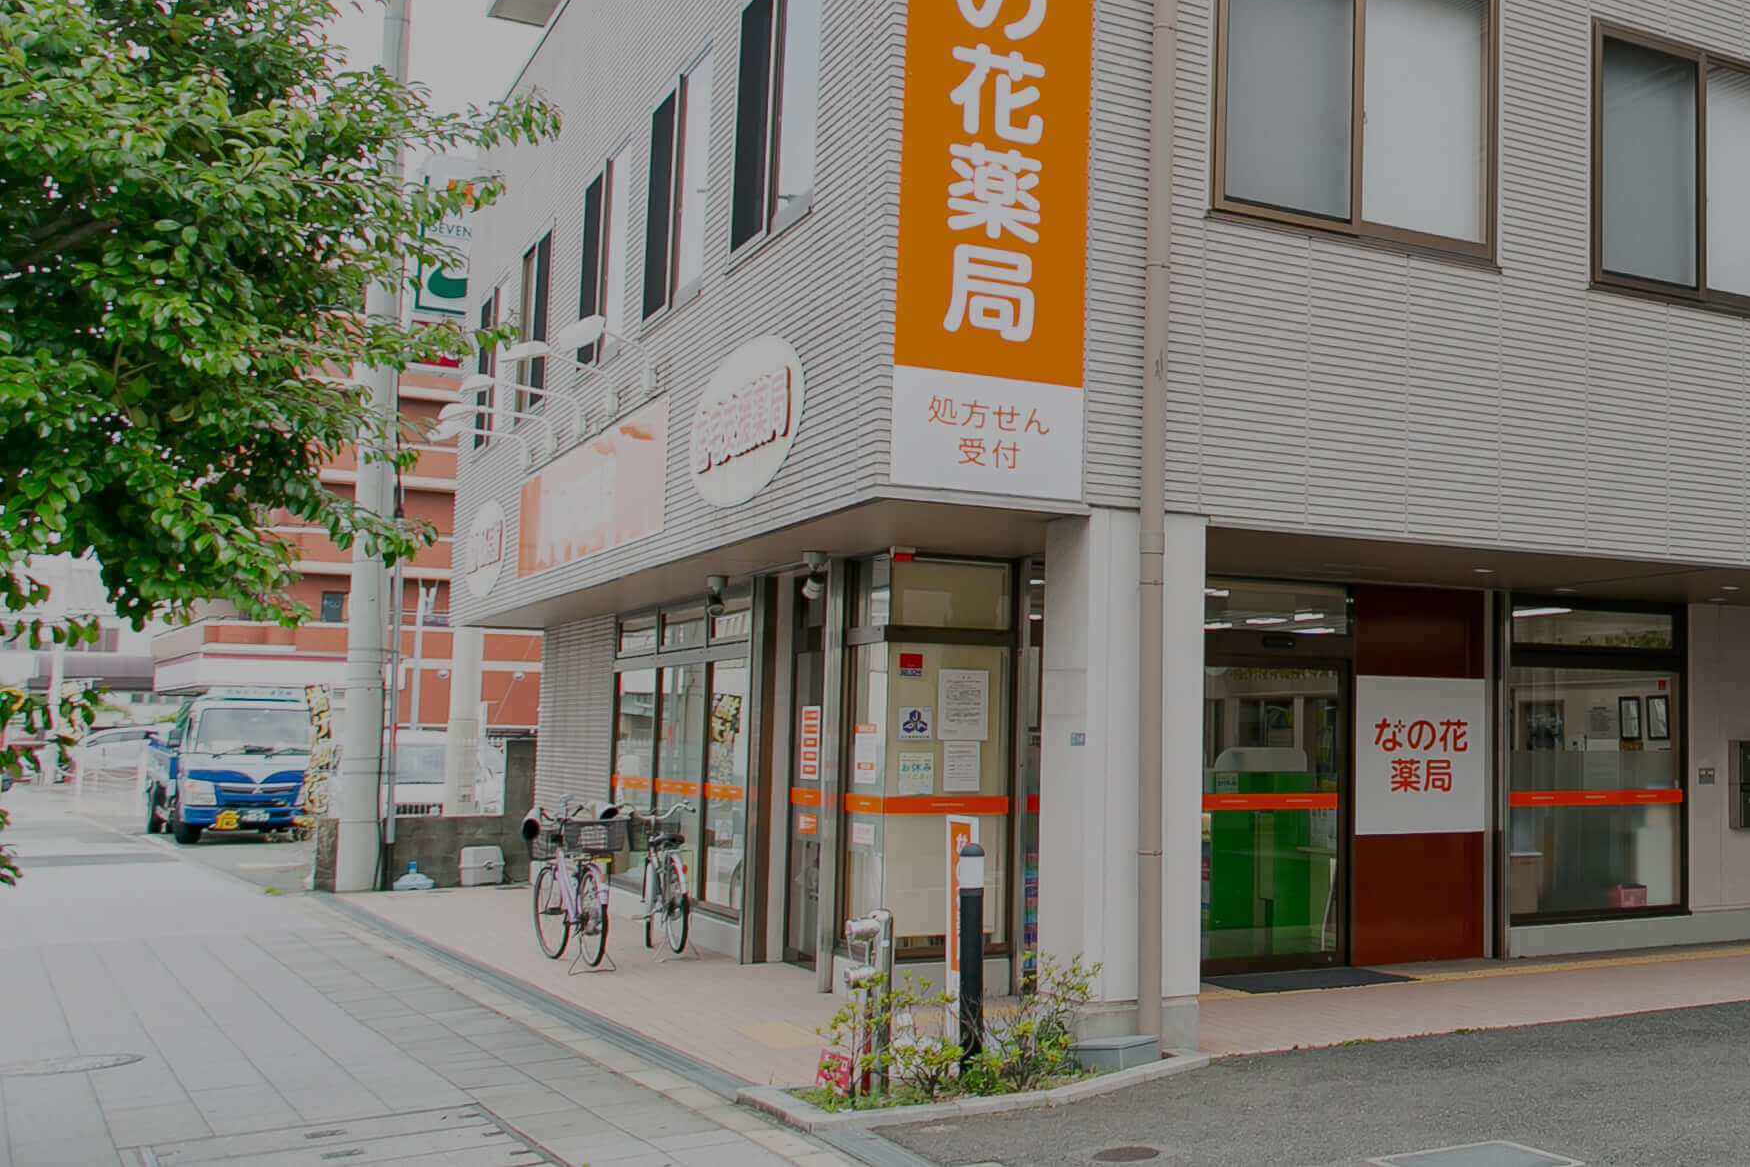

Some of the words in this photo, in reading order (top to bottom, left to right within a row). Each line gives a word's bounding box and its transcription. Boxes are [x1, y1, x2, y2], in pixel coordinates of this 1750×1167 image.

[927, 394, 1051, 436] 処方せん
[957, 438, 1022, 470] 受付
[1373, 717, 1469, 752] なの花
[1389, 758, 1453, 793] 薬局
